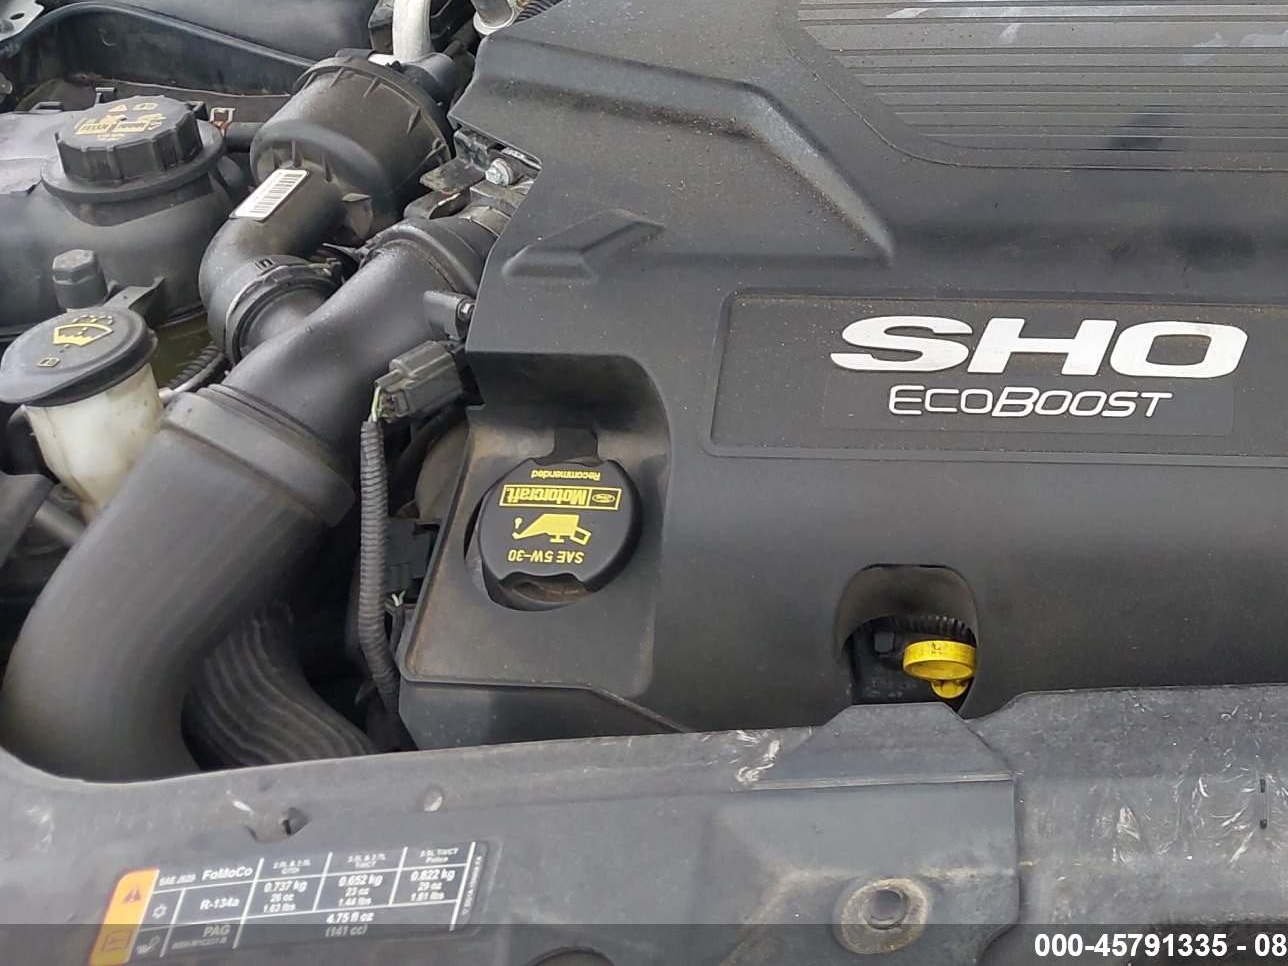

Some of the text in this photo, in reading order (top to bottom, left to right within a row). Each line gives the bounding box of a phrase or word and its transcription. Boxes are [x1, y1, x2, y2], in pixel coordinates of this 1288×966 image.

[831, 316, 1247, 378] SHO
[531, 469, 601, 481] Recommended
[506, 487, 588, 505] Motorcraft
[508, 549, 585, 563] SAE 5W-30
[201, 866, 254, 881] FoMoCo
[338, 873, 383, 887] 0.652 kg
[441, 868, 456, 882] kg
[263, 880, 308, 893] 0.737 kg
[199, 897, 240, 910] R-134a
[326, 912, 349, 924] 4.75
[360, 912, 375, 922] oz
[203, 924, 231, 937] PAG
